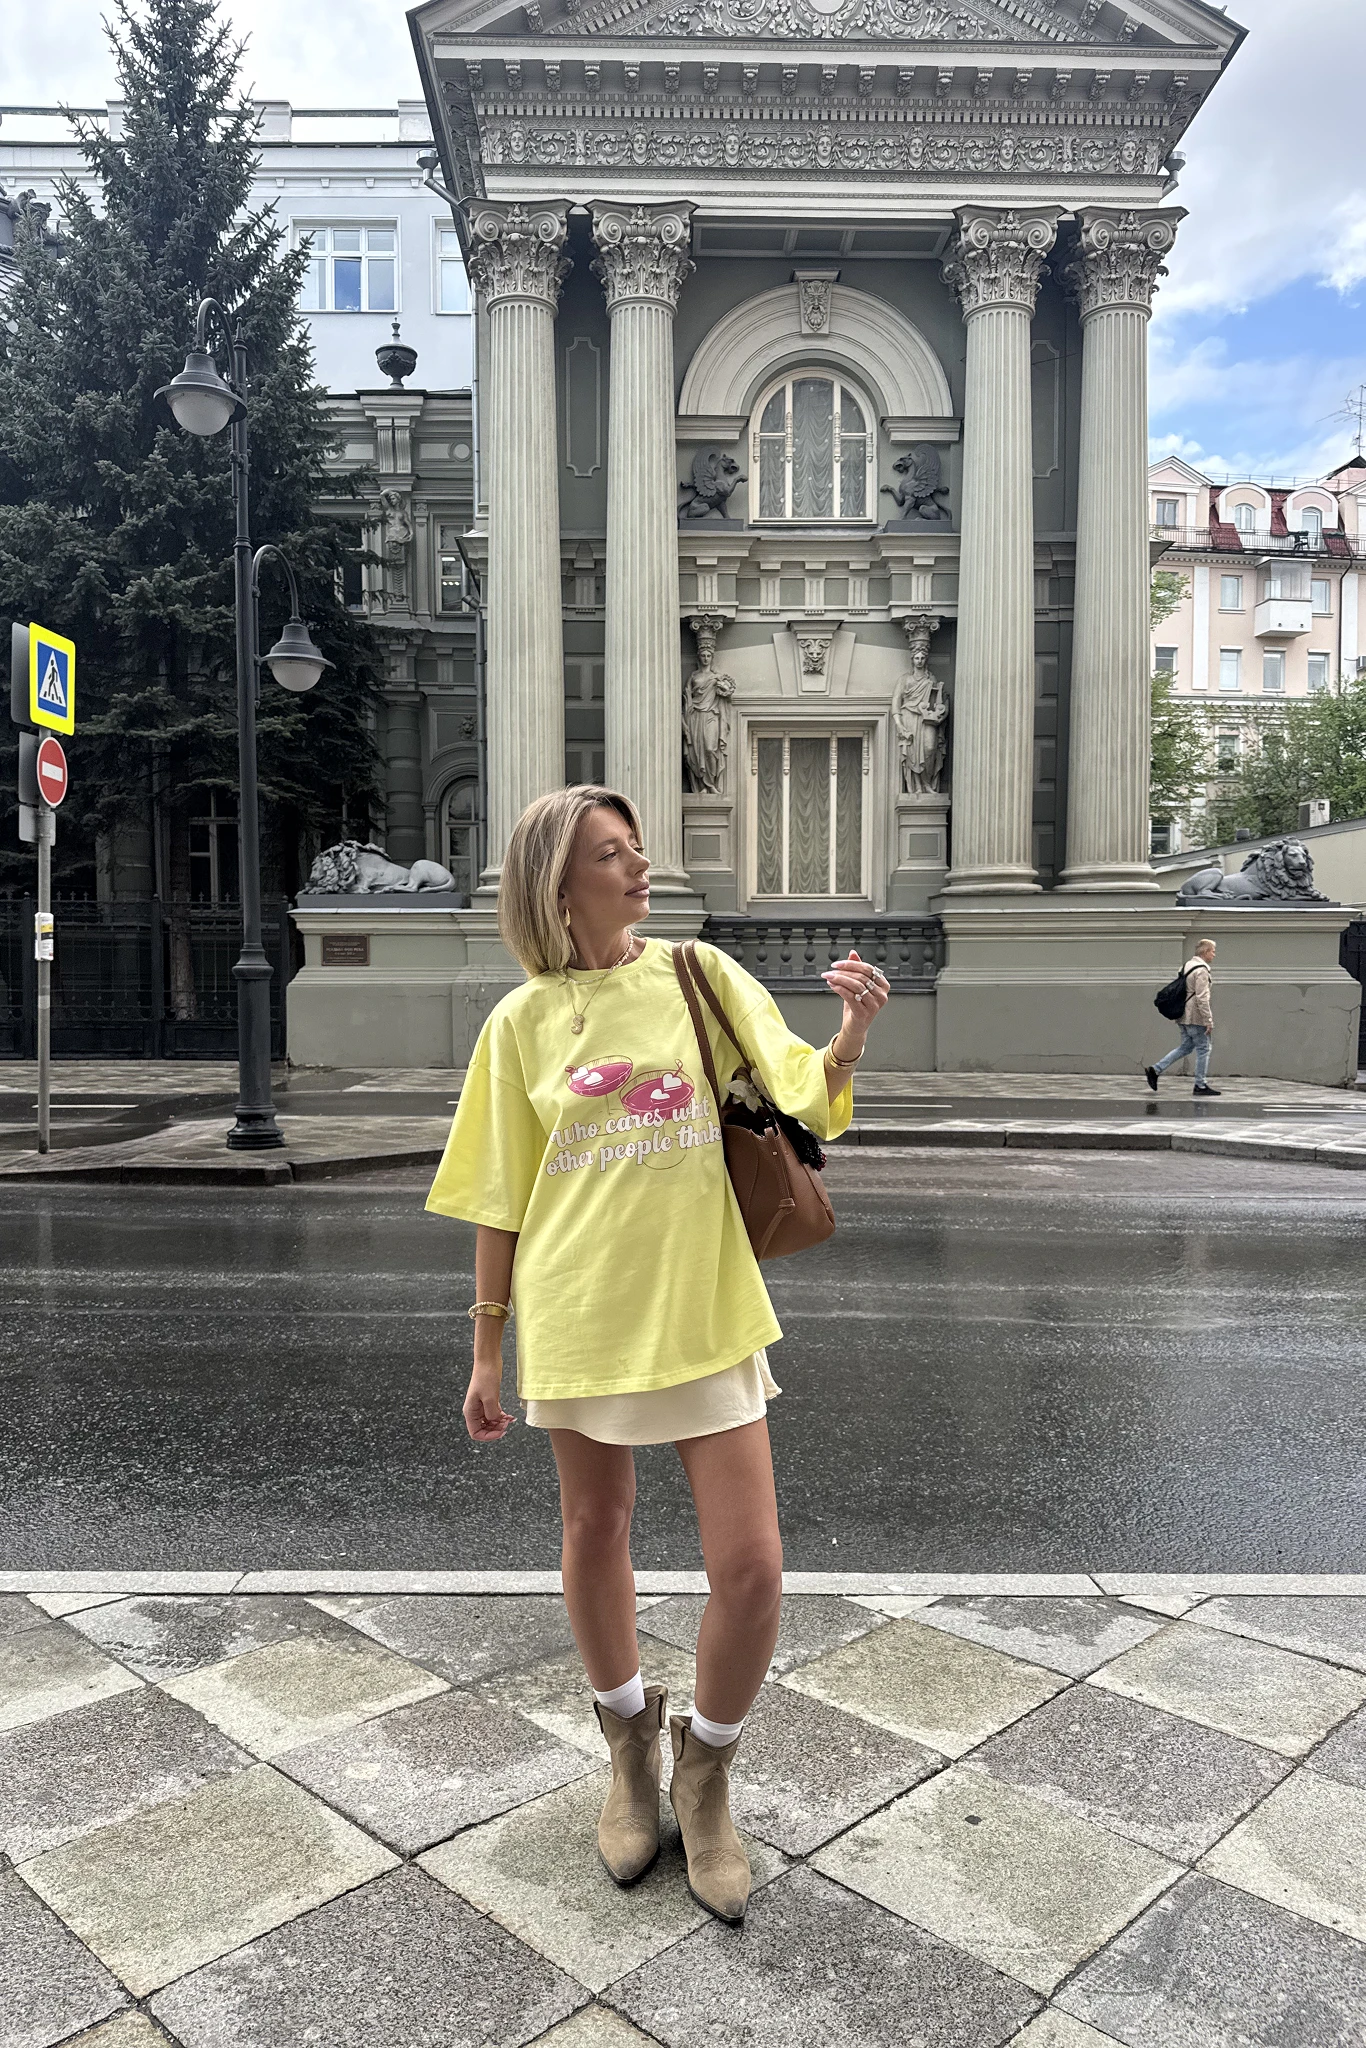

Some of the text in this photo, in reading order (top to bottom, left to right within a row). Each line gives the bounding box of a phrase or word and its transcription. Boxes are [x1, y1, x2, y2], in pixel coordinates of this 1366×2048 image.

[546, 1120, 722, 1176] other people thnk
[550, 1121, 600, 1148] Who
[605, 1108, 666, 1134] cares
